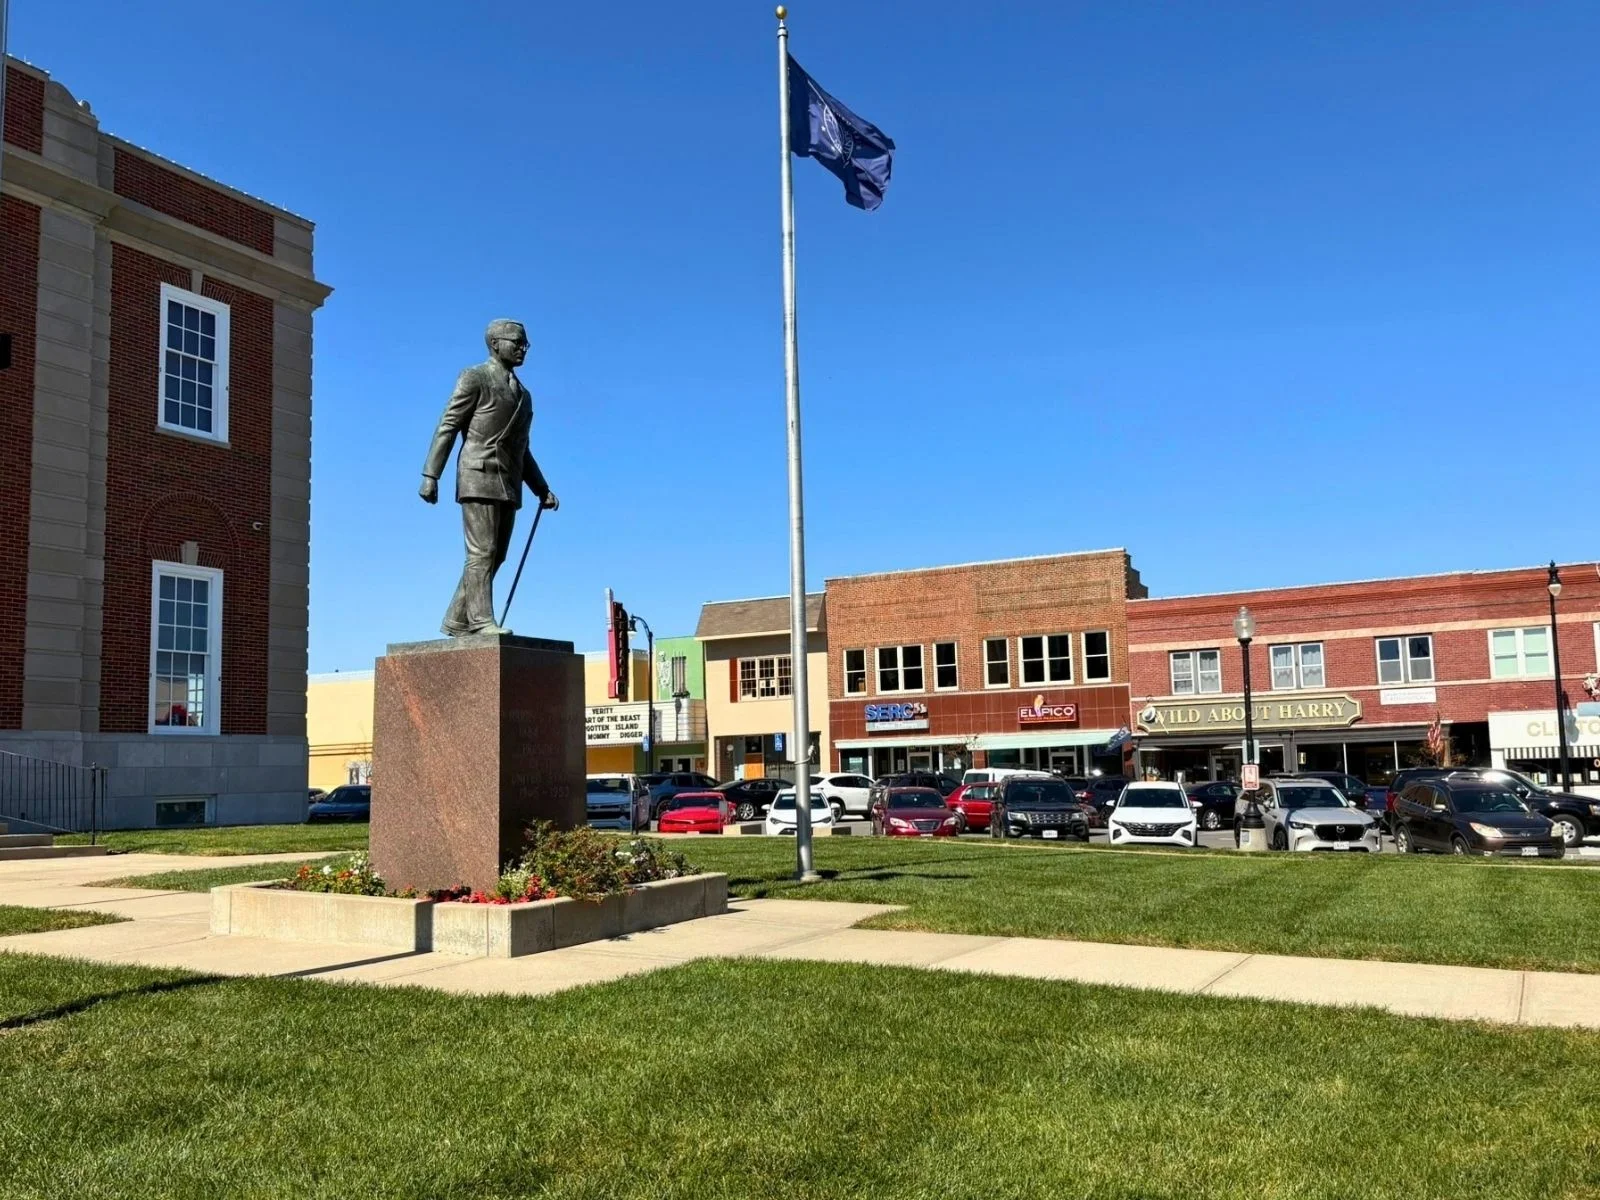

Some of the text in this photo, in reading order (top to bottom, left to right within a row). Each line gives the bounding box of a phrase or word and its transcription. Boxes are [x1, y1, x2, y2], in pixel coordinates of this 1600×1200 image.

[620, 714, 640, 722] BEAST
[865, 703, 914, 720] SERC
[1020, 706, 1074, 718] EL PICO
[1208, 706, 1271, 723] ABOUT
[1280, 702, 1345, 719] HARRY
[1527, 719, 1600, 737] CLITO
